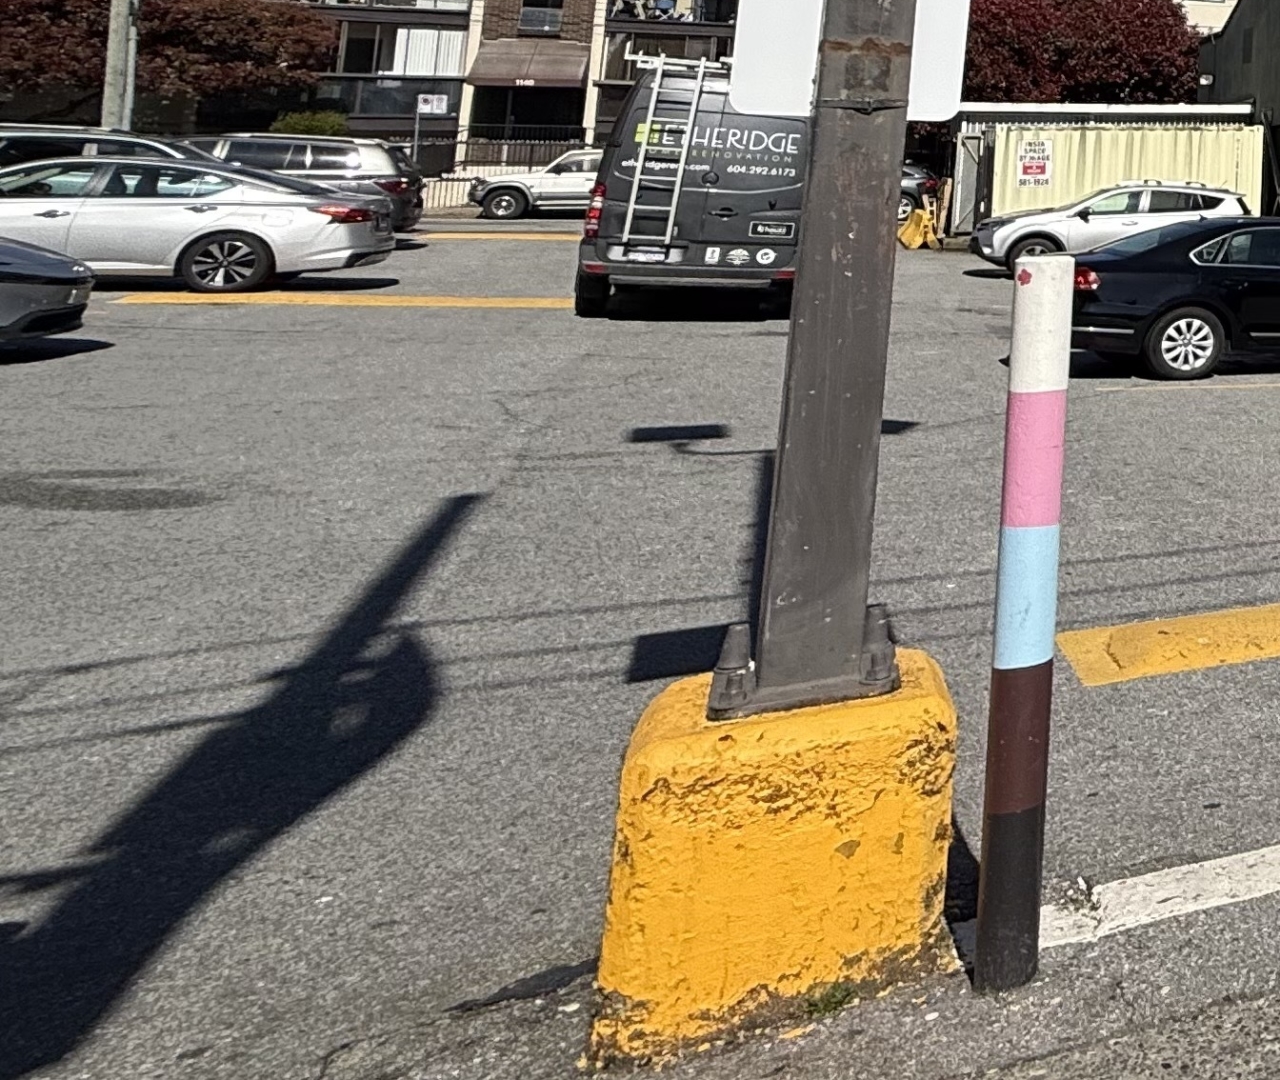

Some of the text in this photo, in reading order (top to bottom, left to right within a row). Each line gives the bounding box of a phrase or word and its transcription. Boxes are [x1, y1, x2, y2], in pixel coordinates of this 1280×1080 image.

[662, 124, 801, 154] ETHERIDGE
[692, 149, 793, 162] RENOVATION
[727, 165, 796, 177] 604.292.6173
